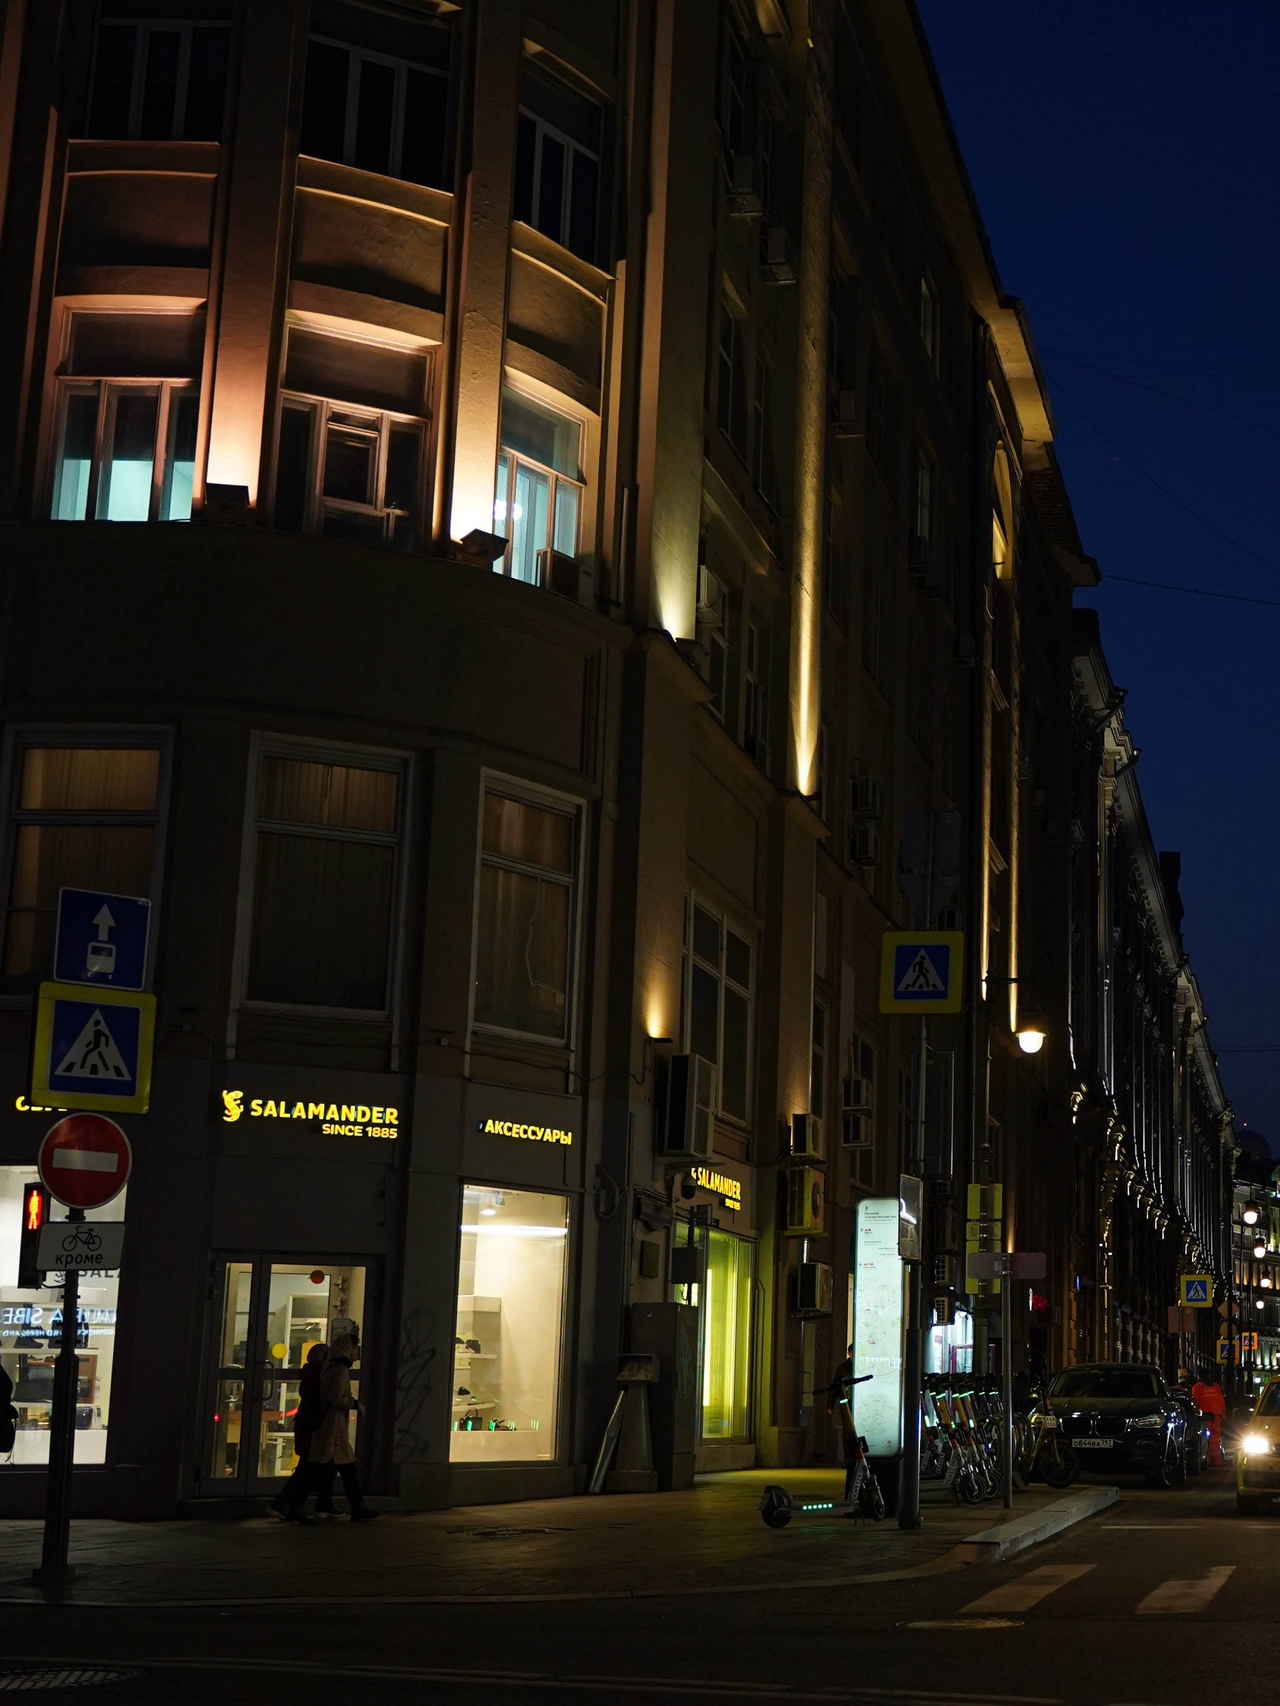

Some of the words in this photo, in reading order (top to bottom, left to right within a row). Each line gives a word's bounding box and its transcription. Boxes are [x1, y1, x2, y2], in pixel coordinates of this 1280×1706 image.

[250, 1098, 399, 1125] SALAMANDER
[322, 1123, 364, 1136] SINCE
[366, 1126, 398, 1139] 1885
[484, 1119, 572, 1146] АКСЕССУАРЫ
[697, 1166, 741, 1201] SALAMANDER
[55, 1253, 104, 1268] кроме
